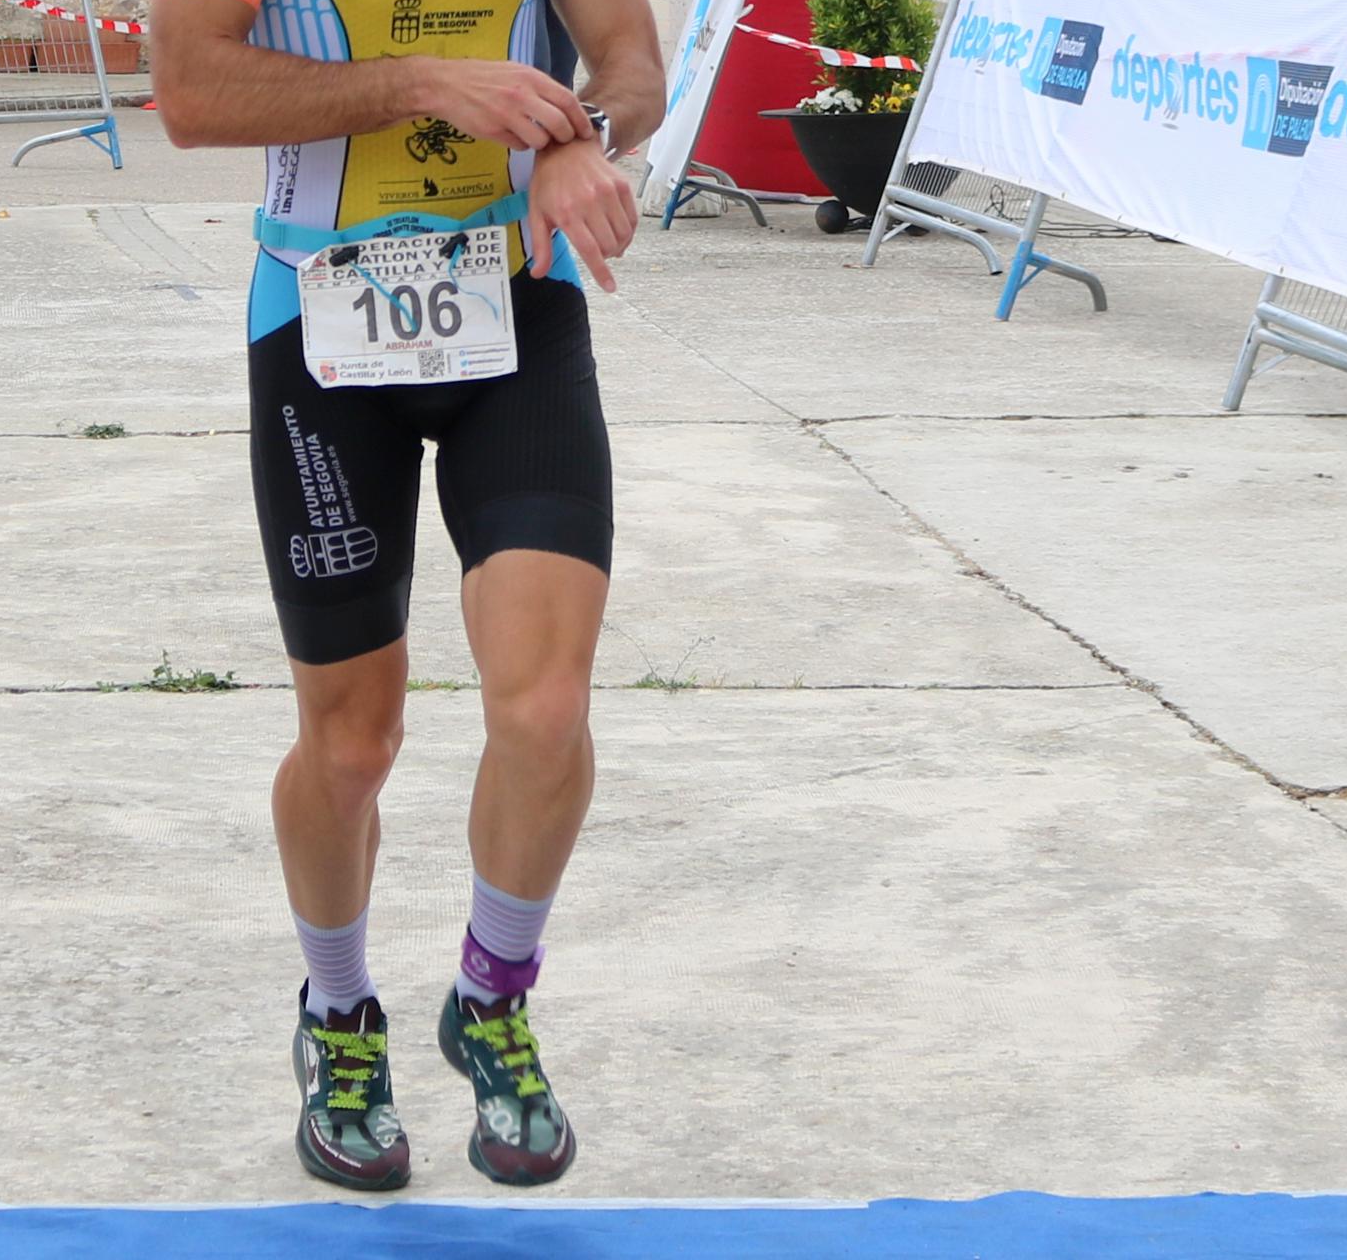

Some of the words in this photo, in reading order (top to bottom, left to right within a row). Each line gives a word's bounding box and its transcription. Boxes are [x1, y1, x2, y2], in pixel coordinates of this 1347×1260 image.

[423, 9, 494, 20] AYUNTAMIENTO
[423, 21, 435, 29] DE
[438, 20, 477, 29] SEGOVIA
[1111, 34, 1239, 121] deportes
[330, 234, 447, 258] FDERACIO
[476, 230, 501, 242] DE
[422, 249, 433, 261] Y
[477, 243, 501, 255] DE
[433, 261, 443, 273] Y
[453, 256, 501, 270] LEON
[353, 281, 463, 342] 106
[385, 340, 433, 351] ABRAHAM
[338, 361, 368, 370] Junta
[370, 360, 384, 368] de
[339, 370, 375, 379] Castilla
[378, 372, 385, 380] y
[388, 368, 413, 377] León
[282, 405, 325, 528] AYUNTAMIENTO
[306, 433, 337, 503] SEGOVIA
[327, 445, 357, 524] www.segovia.es
[327, 507, 344, 527] DE
